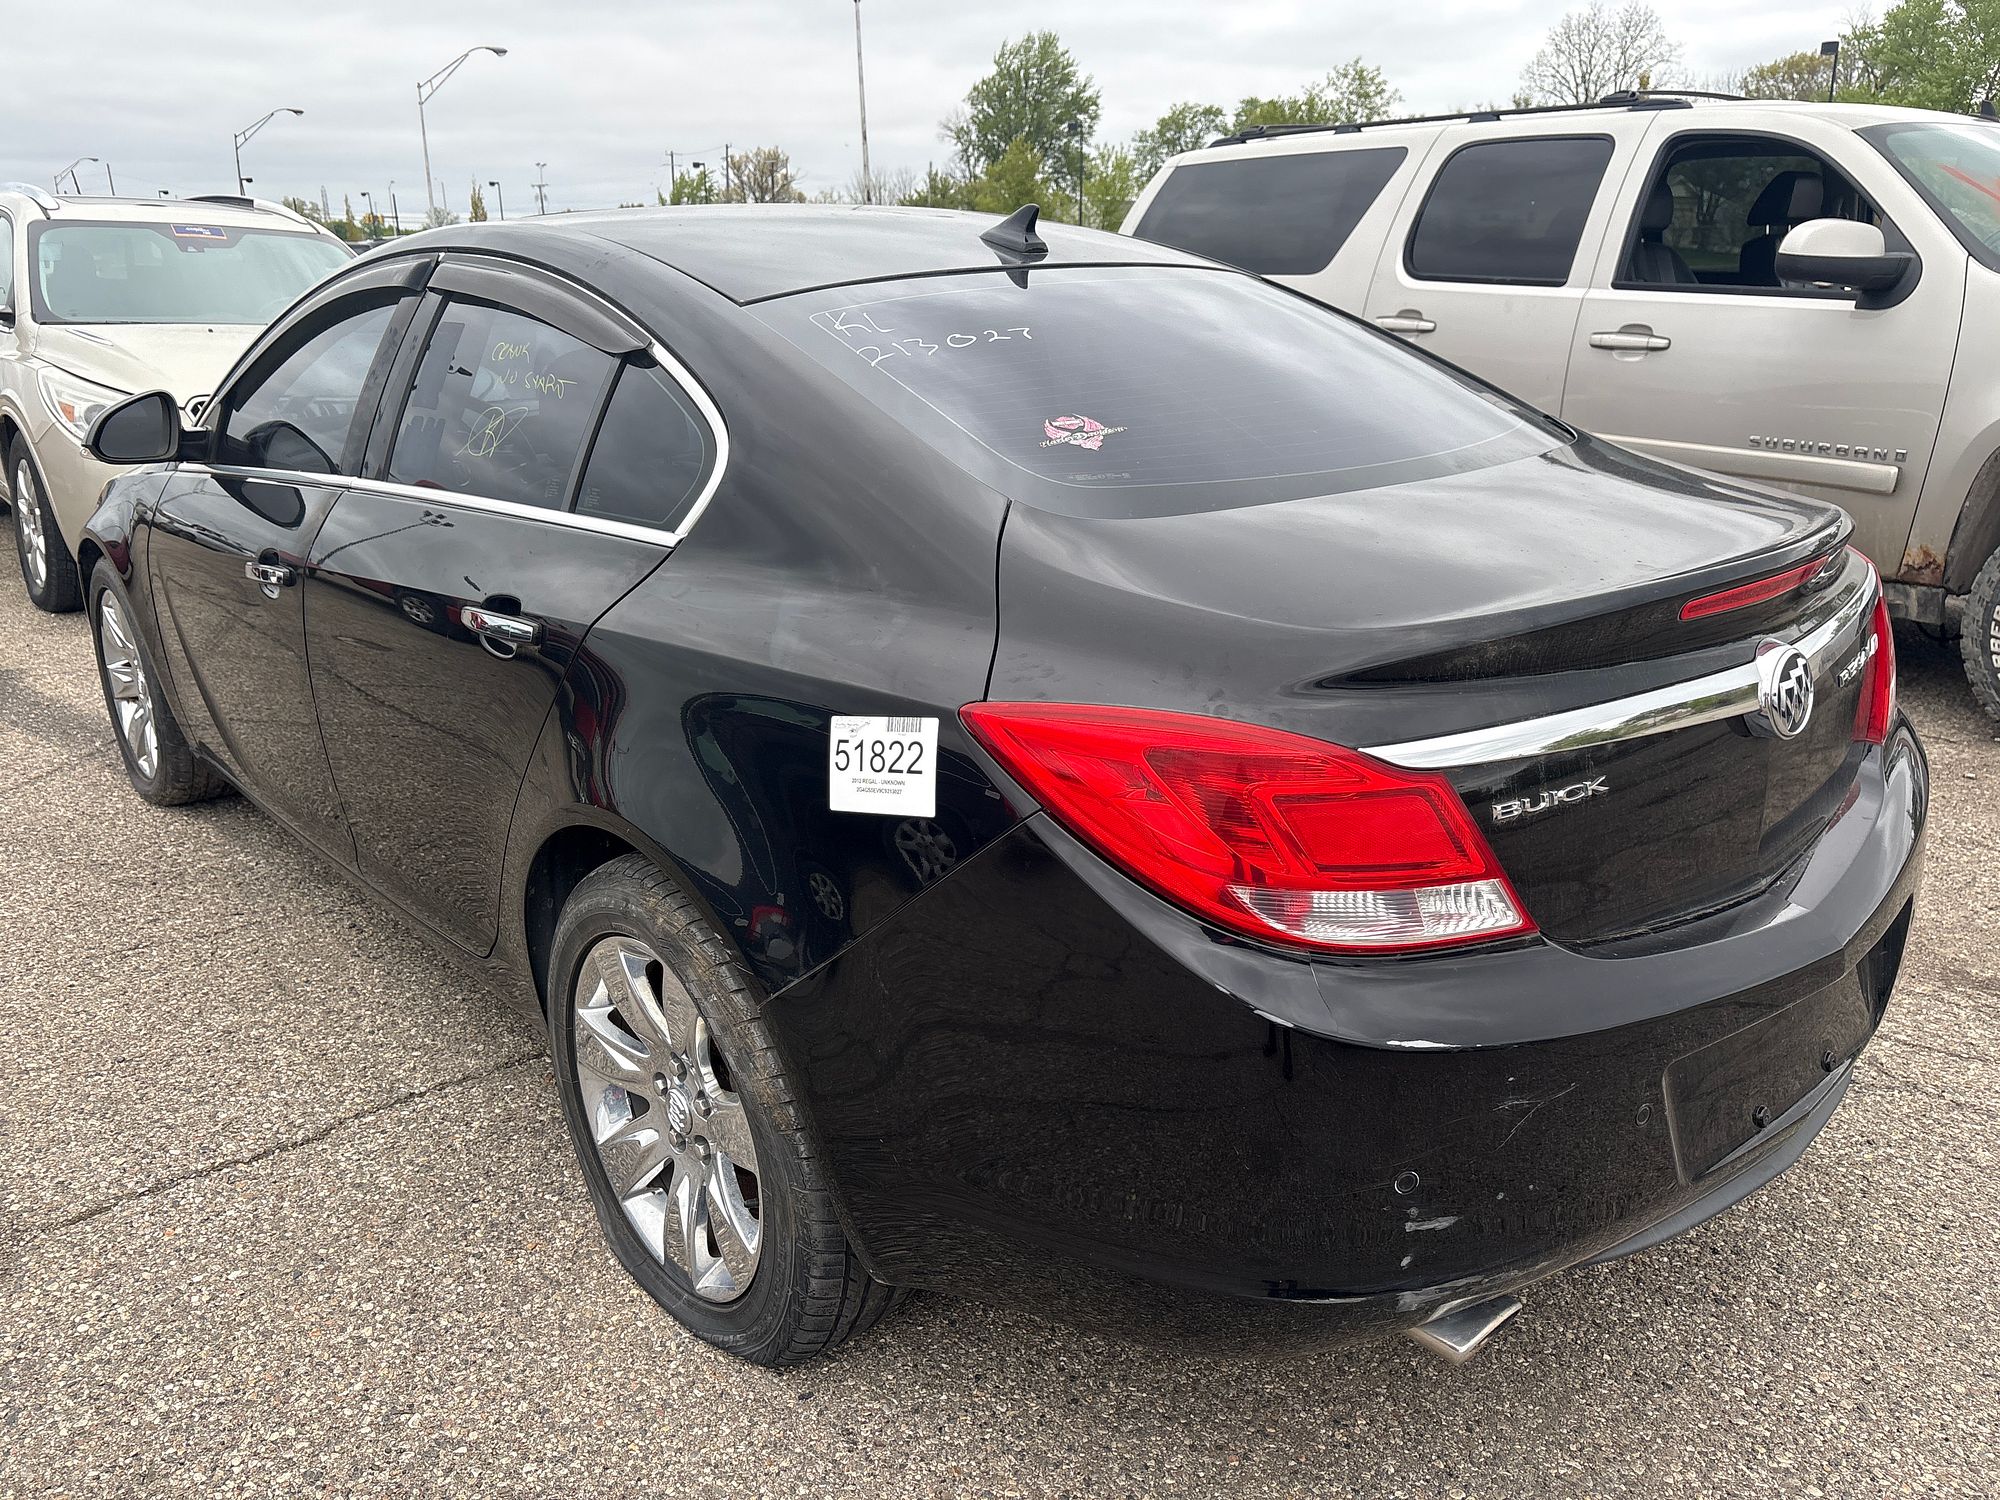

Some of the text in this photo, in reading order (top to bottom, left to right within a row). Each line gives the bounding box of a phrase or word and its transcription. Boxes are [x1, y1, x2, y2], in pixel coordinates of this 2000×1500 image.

[856, 327, 1033, 367] 213027
[1748, 435, 1889, 462] SUBURBAN
[834, 738, 924, 775] 51822
[1491, 775, 1611, 822] BUICK
